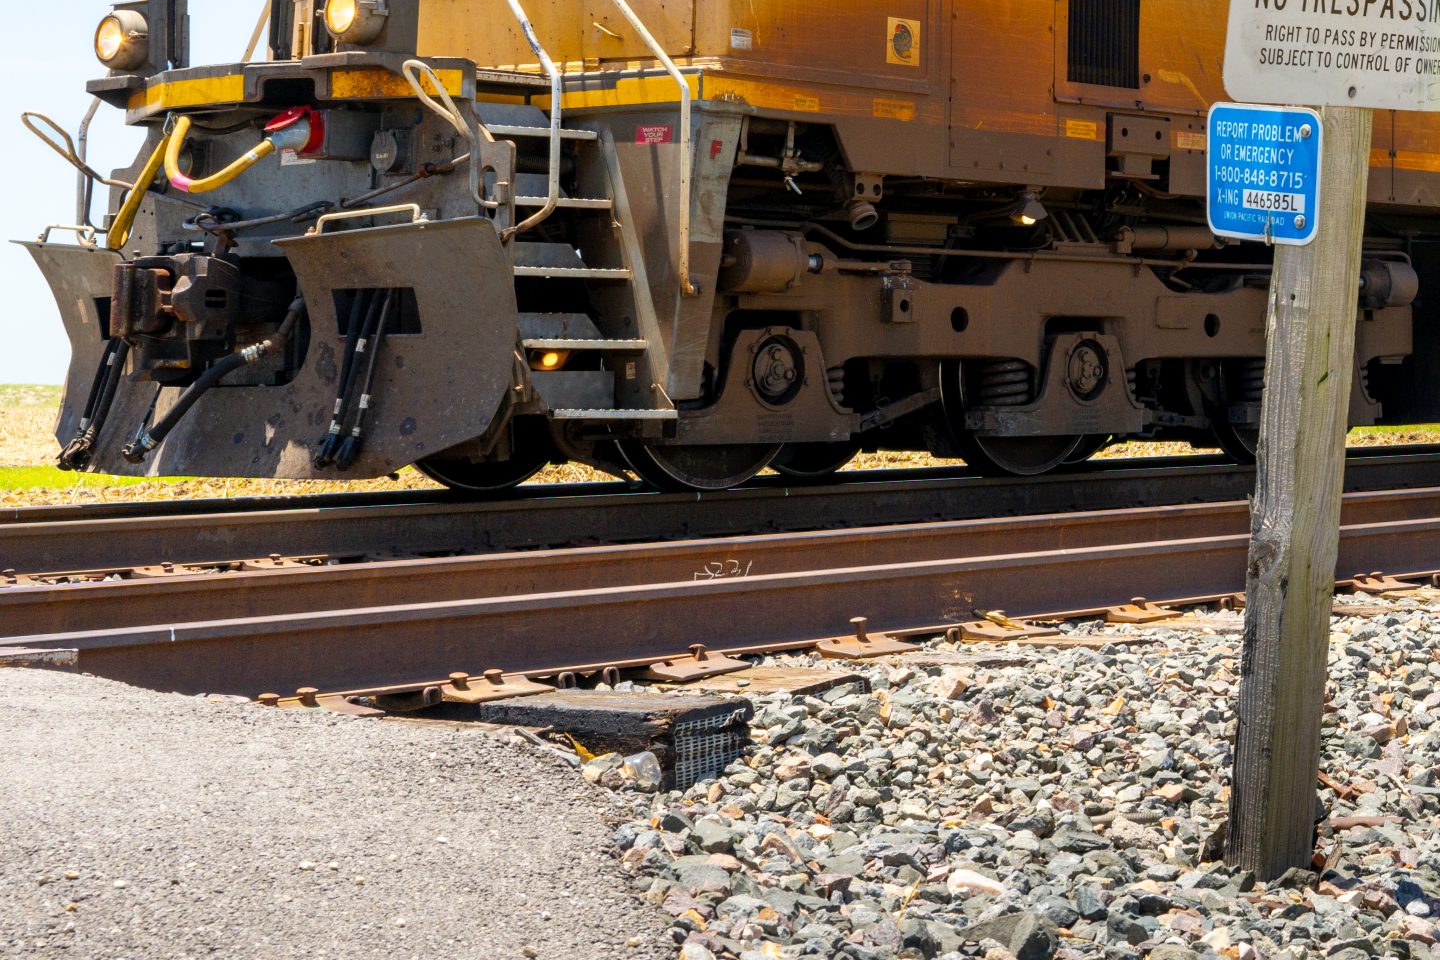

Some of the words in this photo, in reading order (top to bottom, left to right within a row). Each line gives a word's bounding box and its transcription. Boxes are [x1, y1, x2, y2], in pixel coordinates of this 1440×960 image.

[1265, 24, 1302, 43] RIGHT
[1306, 27, 1320, 44] TO
[1324, 29, 1355, 47] PASS
[1360, 31, 1377, 48] BY
[1259, 48, 1314, 67] SUBJECT
[1317, 51, 1331, 68] TO
[1336, 53, 1391, 72] CONTROL
[1395, 56, 1411, 73] OF
[1216, 121, 1249, 138] REPORT
[1251, 123, 1302, 143] PROBLEM
[710, 139, 723, 160] F
[1220, 144, 1231, 160] OR
[1234, 144, 1295, 165] EMERGENCY
[1214, 165, 1304, 189] 1-800-848-8715
[1217, 188, 1239, 205] X-ING
[1246, 191, 1298, 211] 446585L
